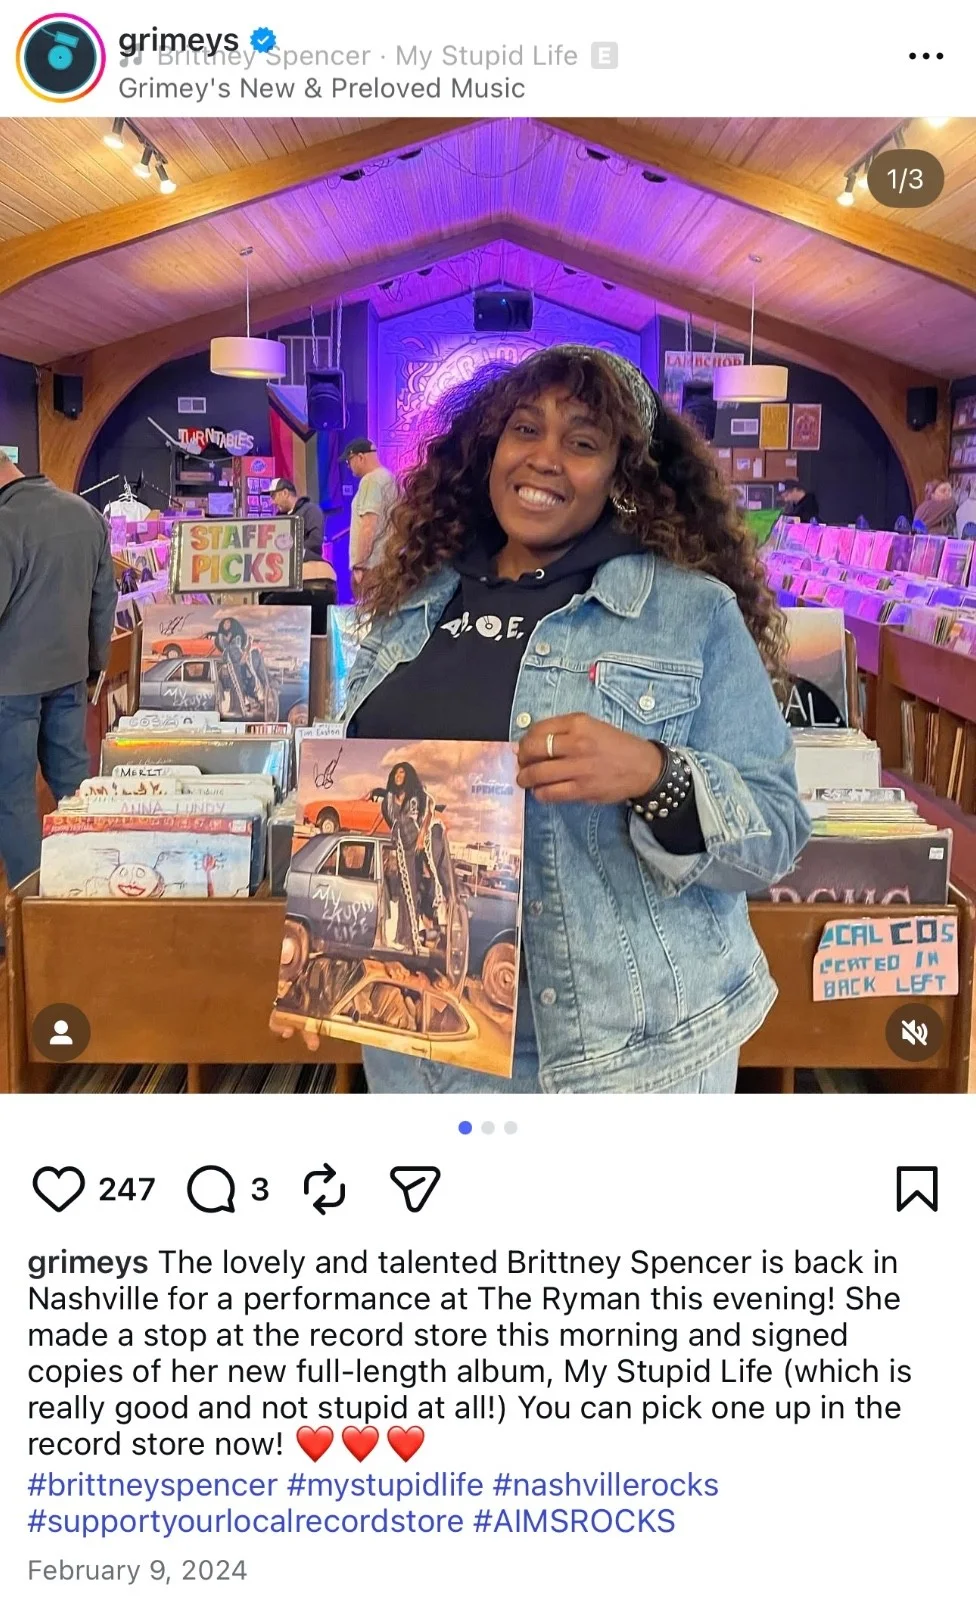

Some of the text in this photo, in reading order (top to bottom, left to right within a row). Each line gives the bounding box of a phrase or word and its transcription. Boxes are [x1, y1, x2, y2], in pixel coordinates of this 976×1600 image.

[178, 427, 255, 450] TURNTABLES
[190, 523, 277, 551] STAFF
[191, 552, 284, 584] PICKS
[312, 885, 342, 912] MY
[824, 973, 946, 998] BACK LEFT
